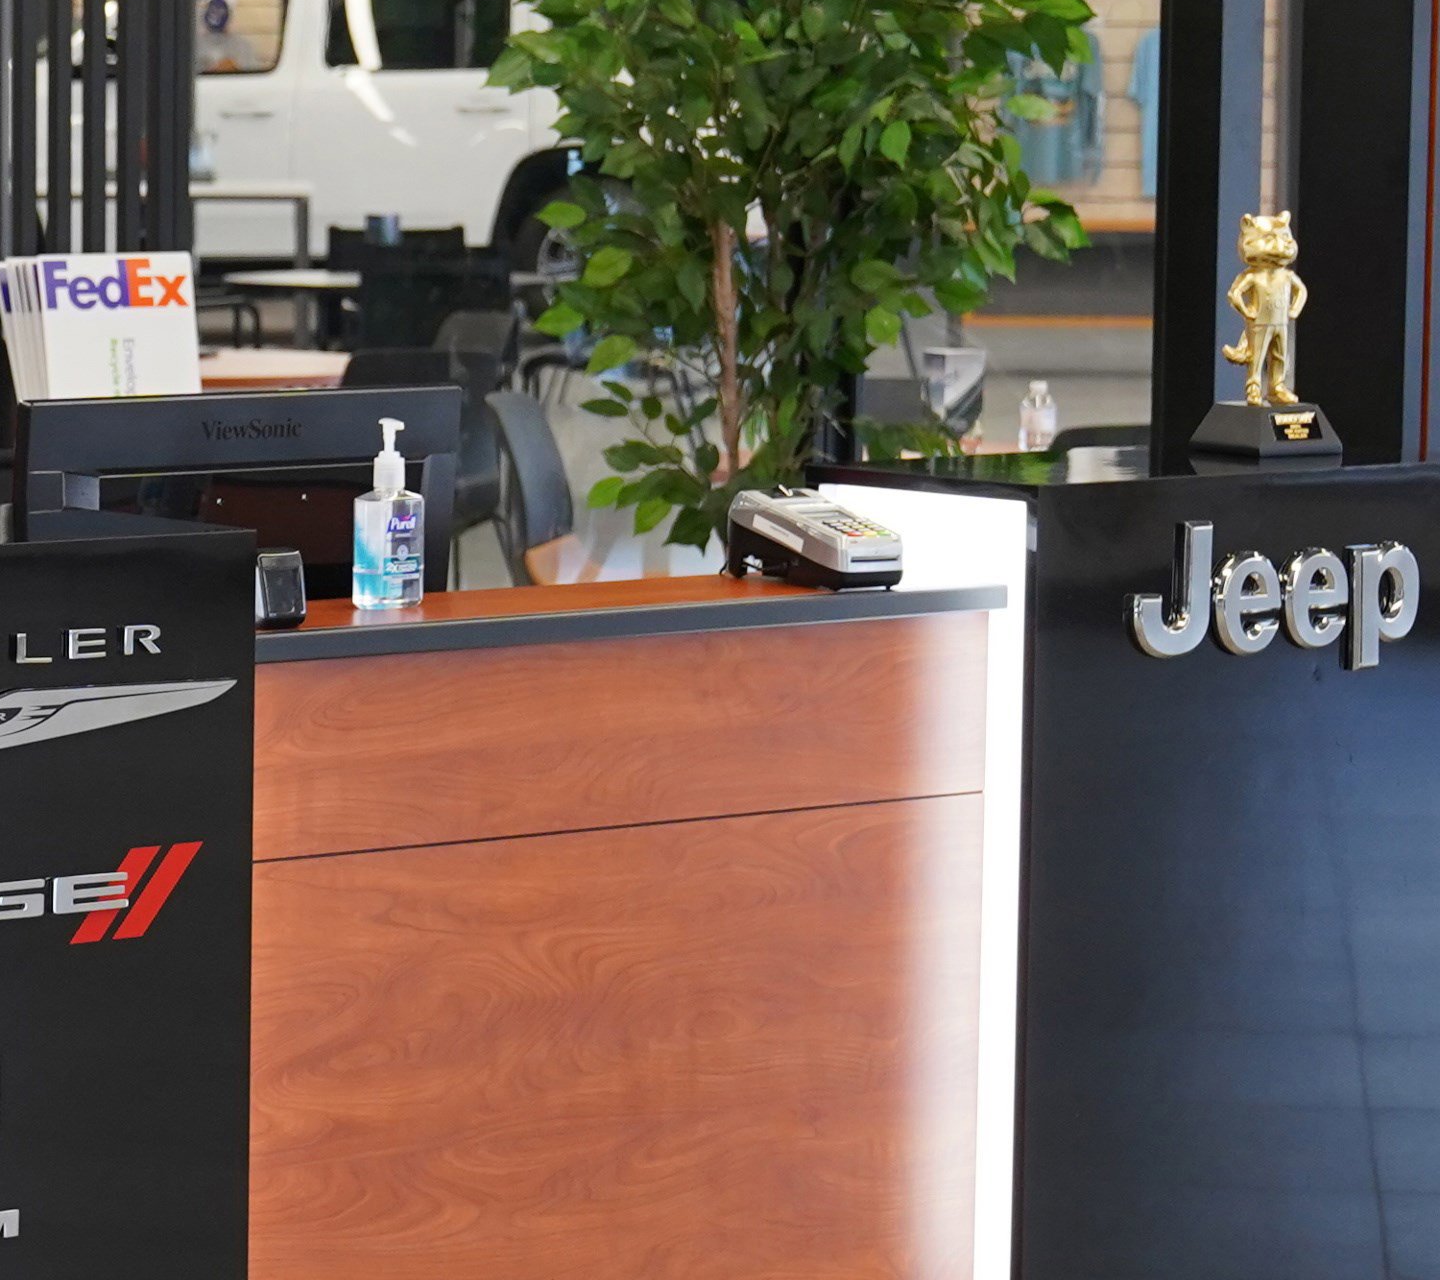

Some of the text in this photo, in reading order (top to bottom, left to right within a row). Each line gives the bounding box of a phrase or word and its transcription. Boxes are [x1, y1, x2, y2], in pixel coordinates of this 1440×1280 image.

[43, 258, 189, 310] FedEx
[202, 419, 303, 440] ViewSonic
[1123, 520, 1419, 670] Jeep
